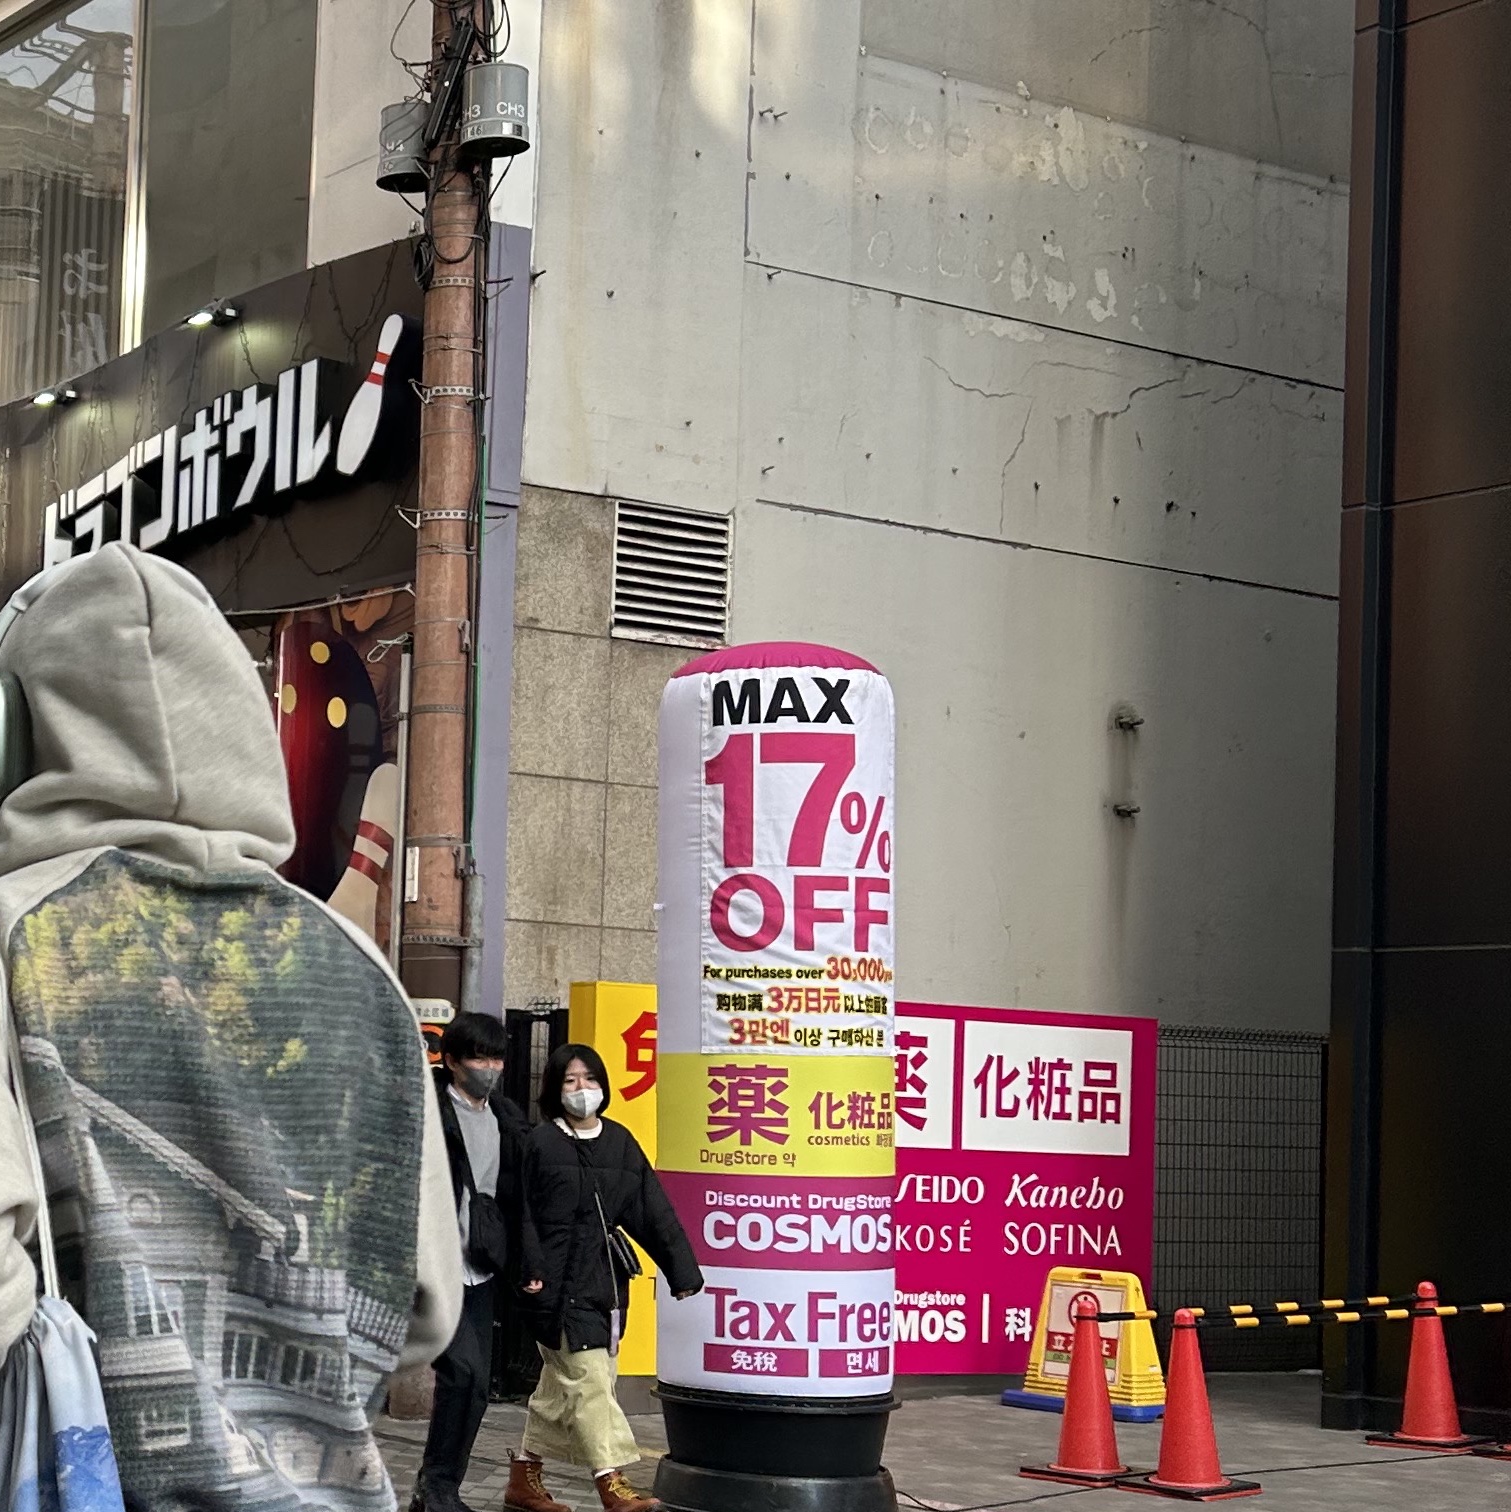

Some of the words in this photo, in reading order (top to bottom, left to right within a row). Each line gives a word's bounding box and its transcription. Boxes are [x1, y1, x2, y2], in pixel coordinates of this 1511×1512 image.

[496, 101, 525, 118] CH3
[711, 676, 856, 727] MAX
[704, 731, 891, 874] 17%
[709, 872, 891, 953] OFF
[703, 964, 721, 979] For
[725, 965, 793, 982] purchases
[796, 967, 825, 979] over
[794, 1027, 823, 1047] 이상
[706, 1063, 790, 1146] 薬
[807, 1090, 892, 1131] 化粧品
[972, 1053, 1123, 1125] 化粧品
[699, 1148, 778, 1167] DrugStore
[782, 1152, 797, 1168] 약
[807, 1133, 871, 1147] cosmetics
[705, 1190, 802, 1210] Discount
[807, 1193, 892, 1212] DrugStore
[1003, 1172, 1125, 1211] Kanebo
[702, 1209, 893, 1254] COSMOS
[894, 1219, 973, 1253] KOSÉ
[1002, 1220, 1123, 1257] SOFINA
[703, 1286, 798, 1343] Tax
[807, 1291, 891, 1344] Free
[893, 1289, 967, 1309] Drugstore
[893, 1308, 968, 1344] MOS
[846, 1350, 880, 1375] 면세
